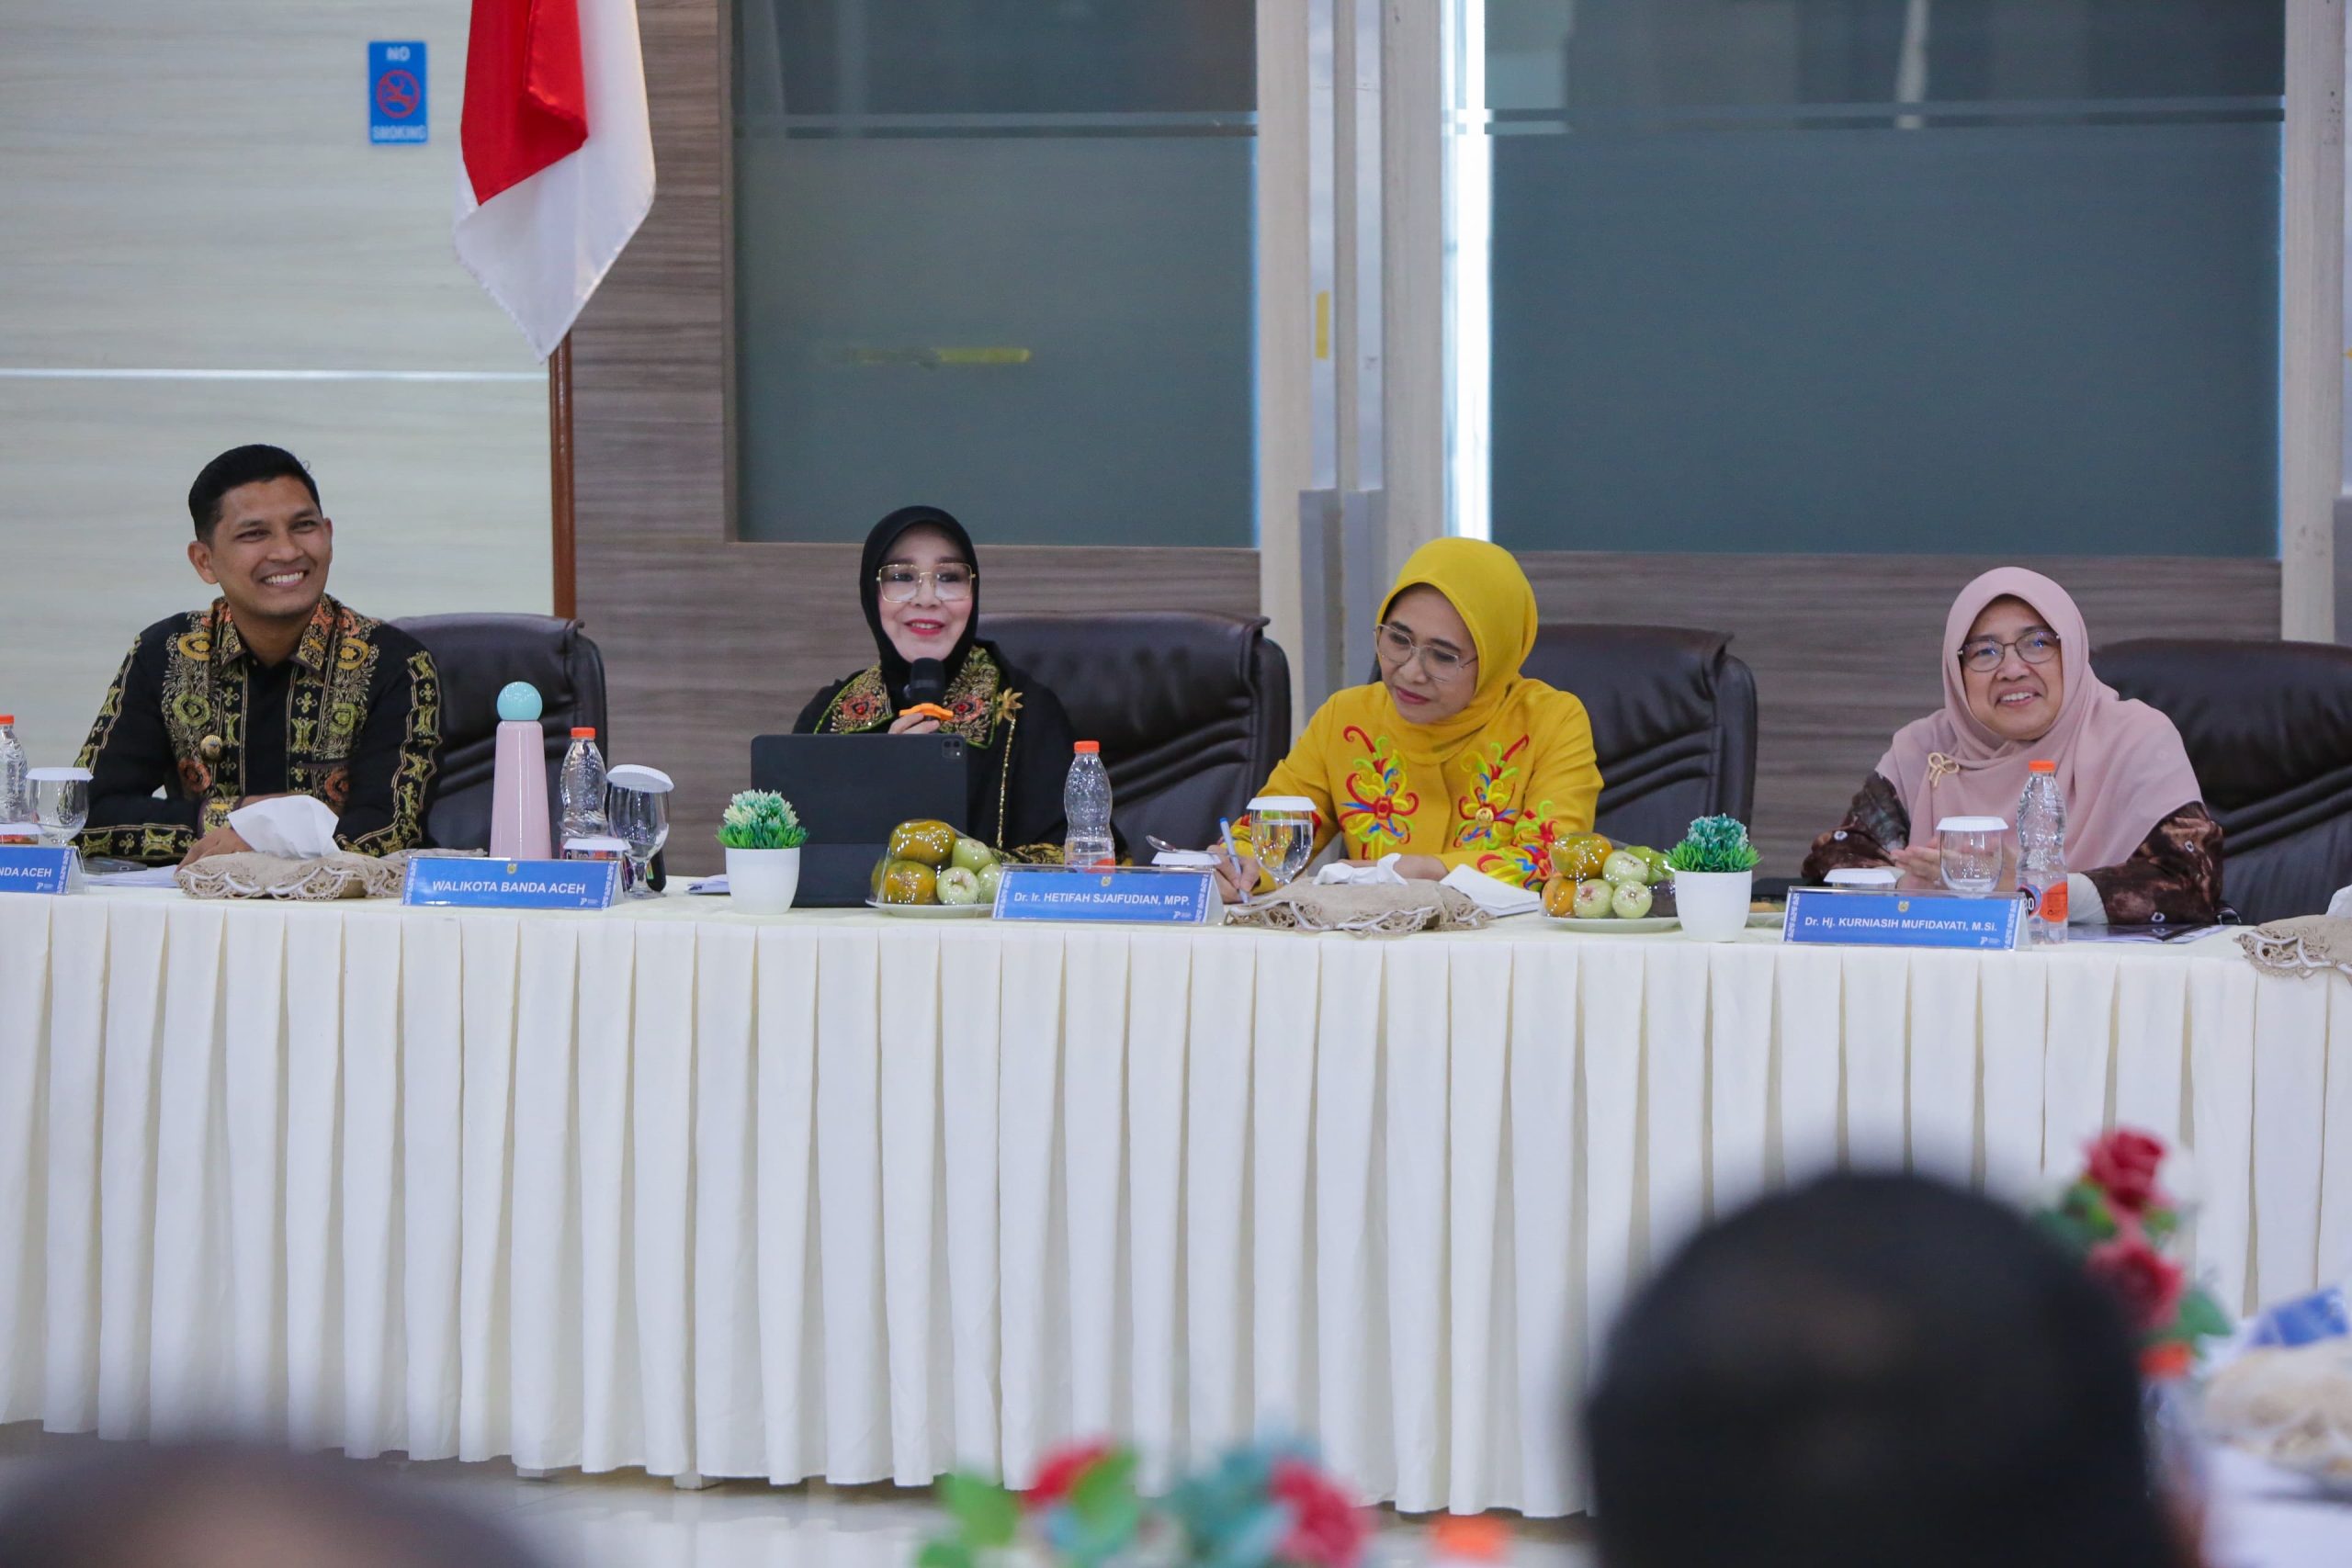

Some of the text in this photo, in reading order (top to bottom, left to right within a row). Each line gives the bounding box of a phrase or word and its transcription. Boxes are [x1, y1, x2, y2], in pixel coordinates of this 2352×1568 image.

[387, 46, 411, 62] NO
[20, 868, 52, 878] ACEH
[432, 881, 586, 895] WALIKOTA BANDA ACEH
[1013, 892, 1190, 906] Dr. Ir. HETIFAH SJAIFUDIAN, MPP.
[1804, 917, 1997, 931] Dr. Hj. KURNIASIH MUFIDAYATI, M.Si.
